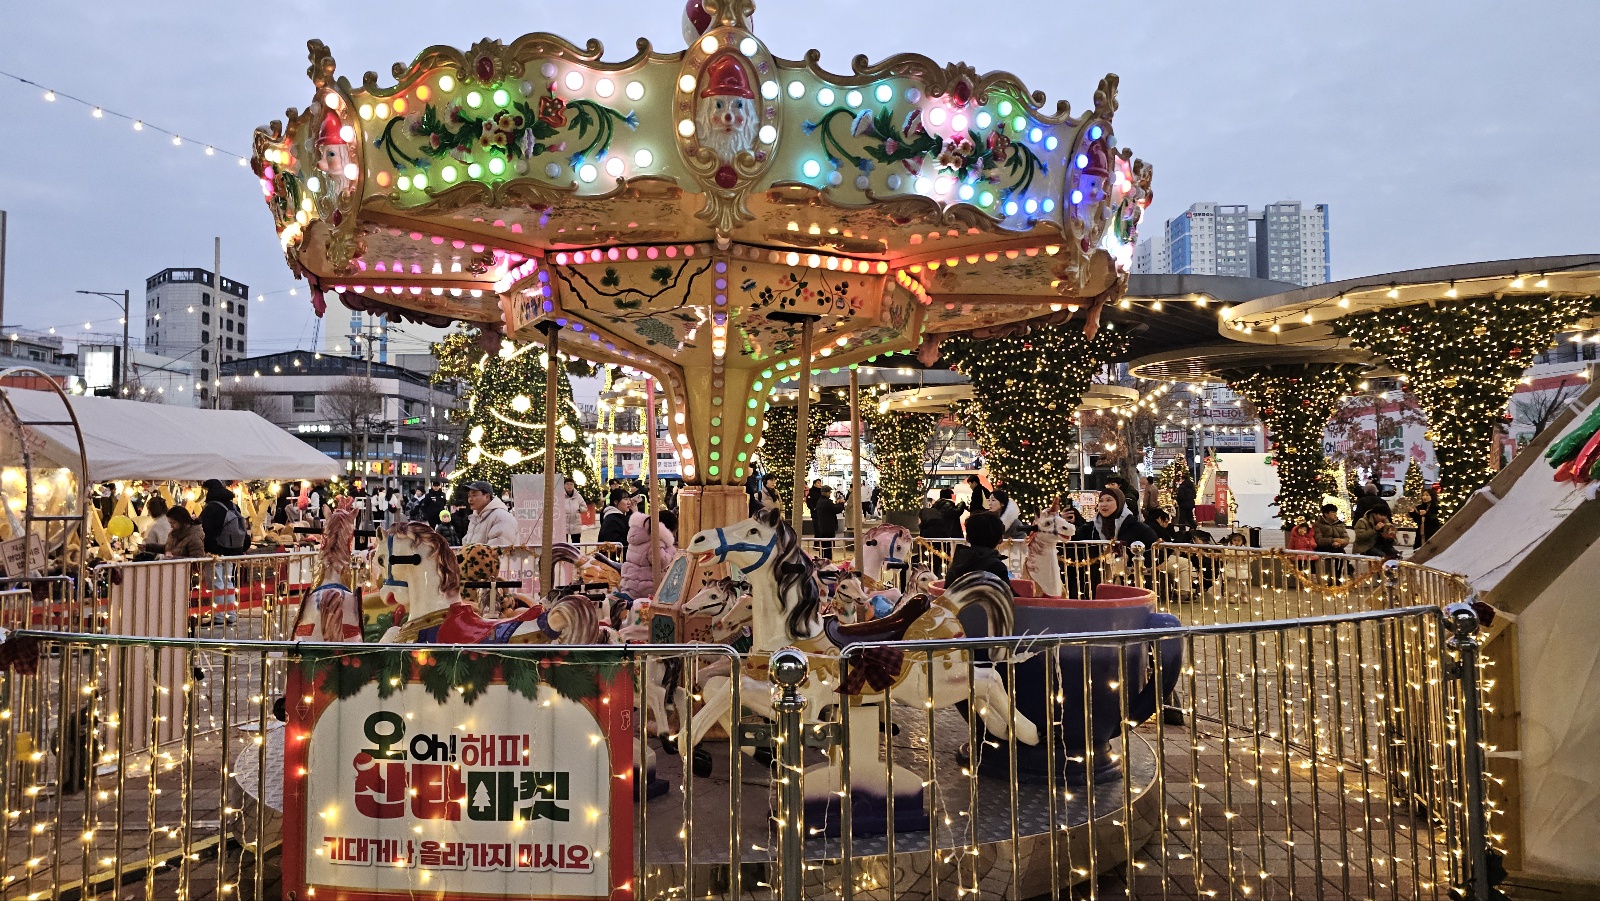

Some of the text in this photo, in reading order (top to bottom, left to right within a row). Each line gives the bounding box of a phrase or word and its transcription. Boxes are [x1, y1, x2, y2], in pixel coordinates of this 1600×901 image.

[361, 710, 407, 760] 오
[460, 733, 530, 767] 해피
[353, 754, 570, 822] 산타마켓
[323, 836, 590, 869] 기대거나 올라가지 마시오
